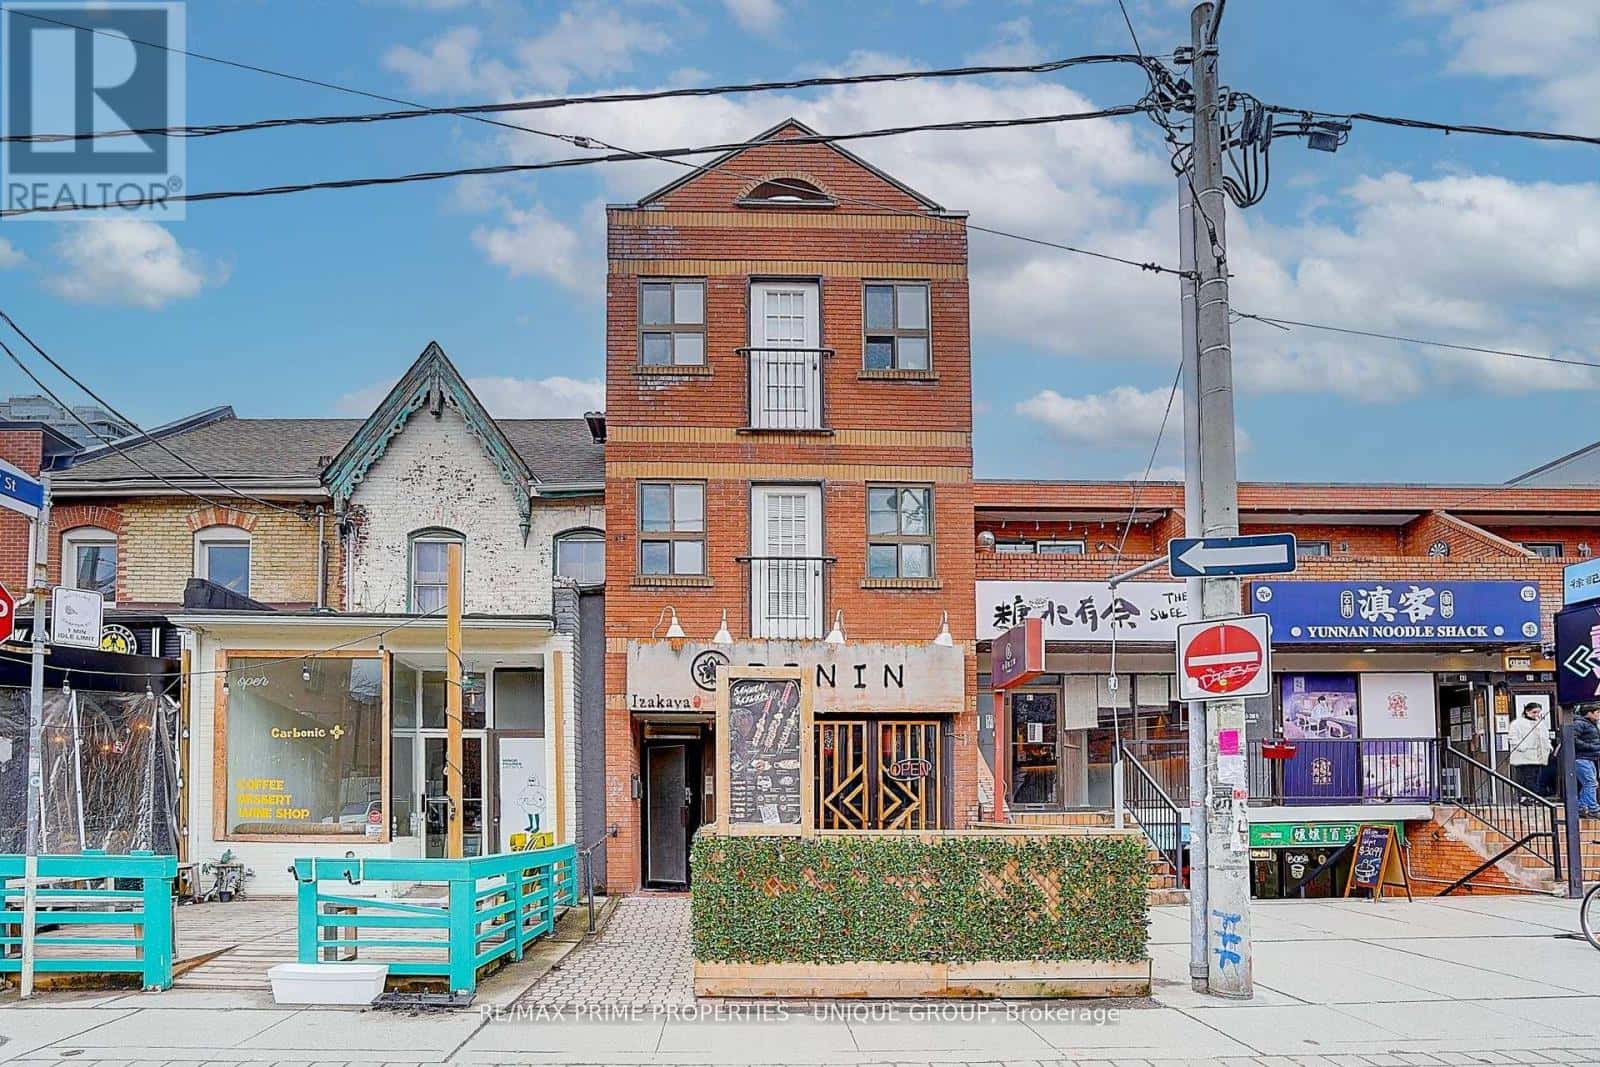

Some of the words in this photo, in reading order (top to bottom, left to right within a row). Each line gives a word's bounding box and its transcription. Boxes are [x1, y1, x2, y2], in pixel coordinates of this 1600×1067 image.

[4, 477, 16, 492] St
[1161, 592, 1188, 604] THE
[1307, 626, 1369, 638] YUNNAN
[1373, 626, 1434, 638] NOODLE
[1437, 626, 1488, 638] SHACK
[631, 694, 691, 709] Izakaya
[271, 727, 326, 739] Carbonic
[889, 762, 929, 777] OPEN
[276, 808, 310, 819] SHOP
